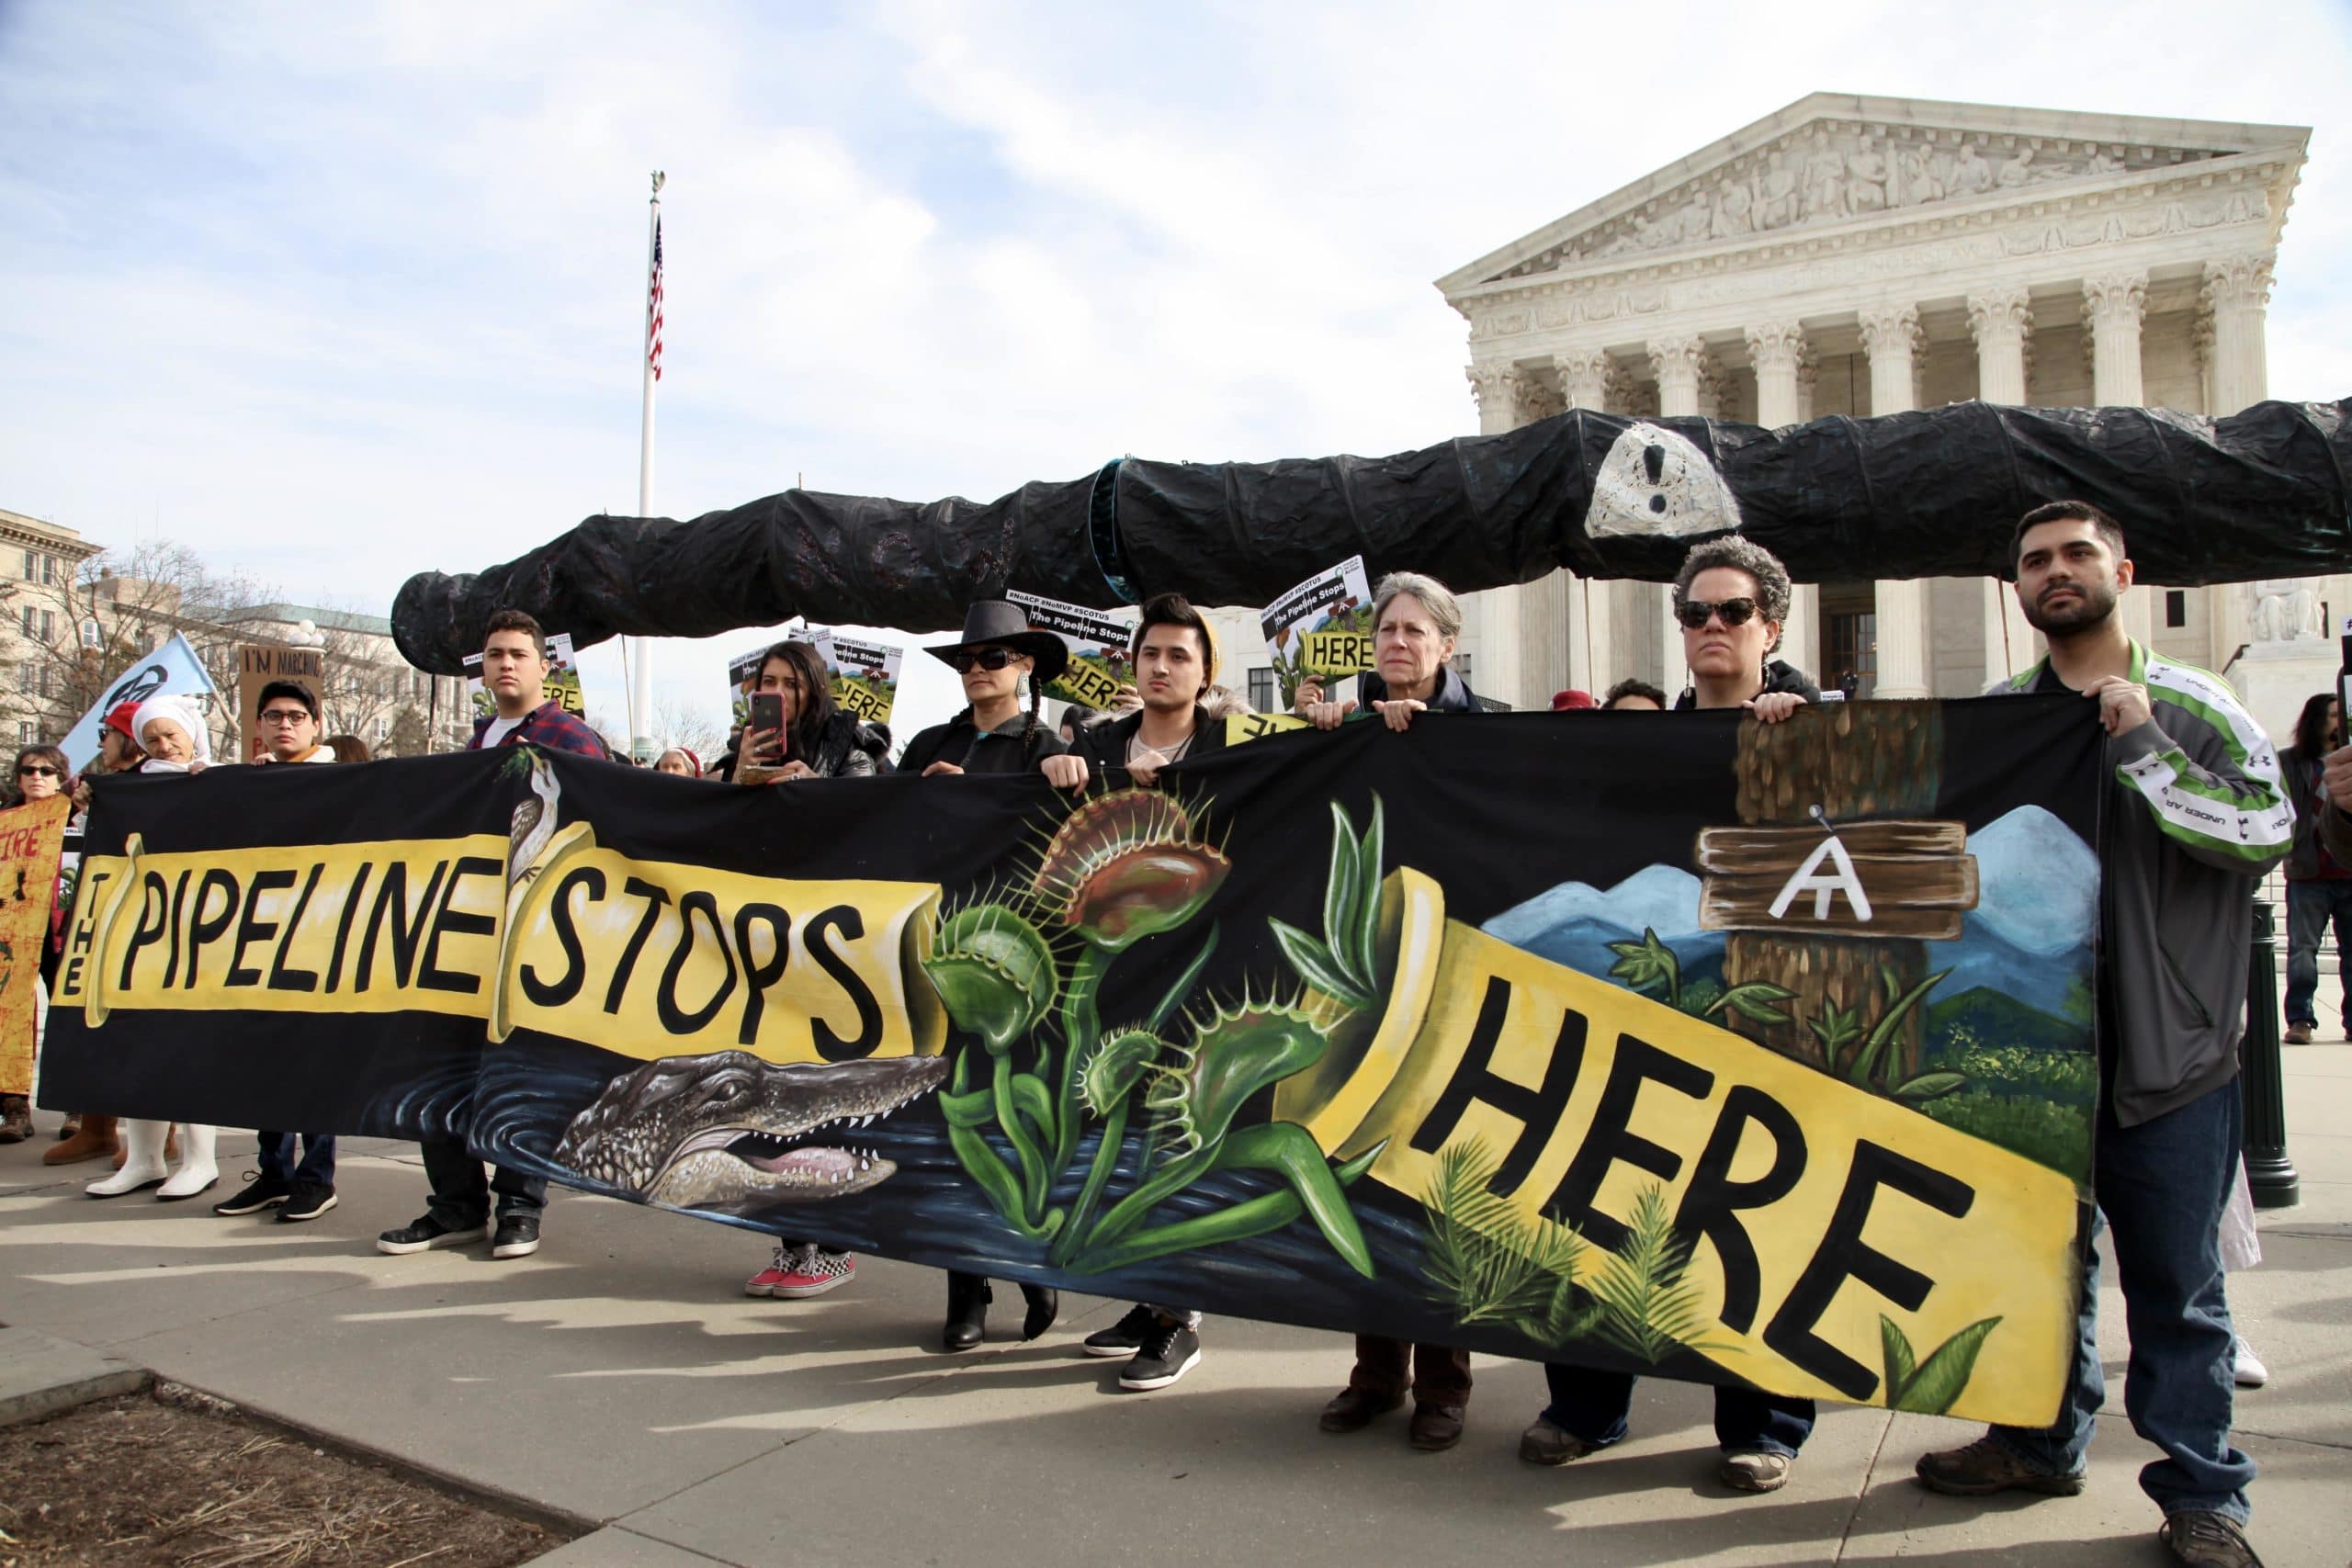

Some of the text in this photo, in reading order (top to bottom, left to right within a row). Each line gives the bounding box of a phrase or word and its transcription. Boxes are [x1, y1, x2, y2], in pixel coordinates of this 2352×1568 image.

[1009, 592, 1110, 621] #NoACP #NoMVP #SCOTUS
[1288, 594, 1317, 618] Pipeline
[1318, 581, 1345, 600] Stops
[1031, 612, 1130, 642] The Pipeline Stops
[840, 637, 868, 648] #SCOTUS
[1312, 637, 1375, 668] HERE
[245, 649, 321, 678] I'M MARCHING
[859, 652, 885, 664] Stops
[63, 856, 1976, 1401] THE PIPELINE STOPS HERE
